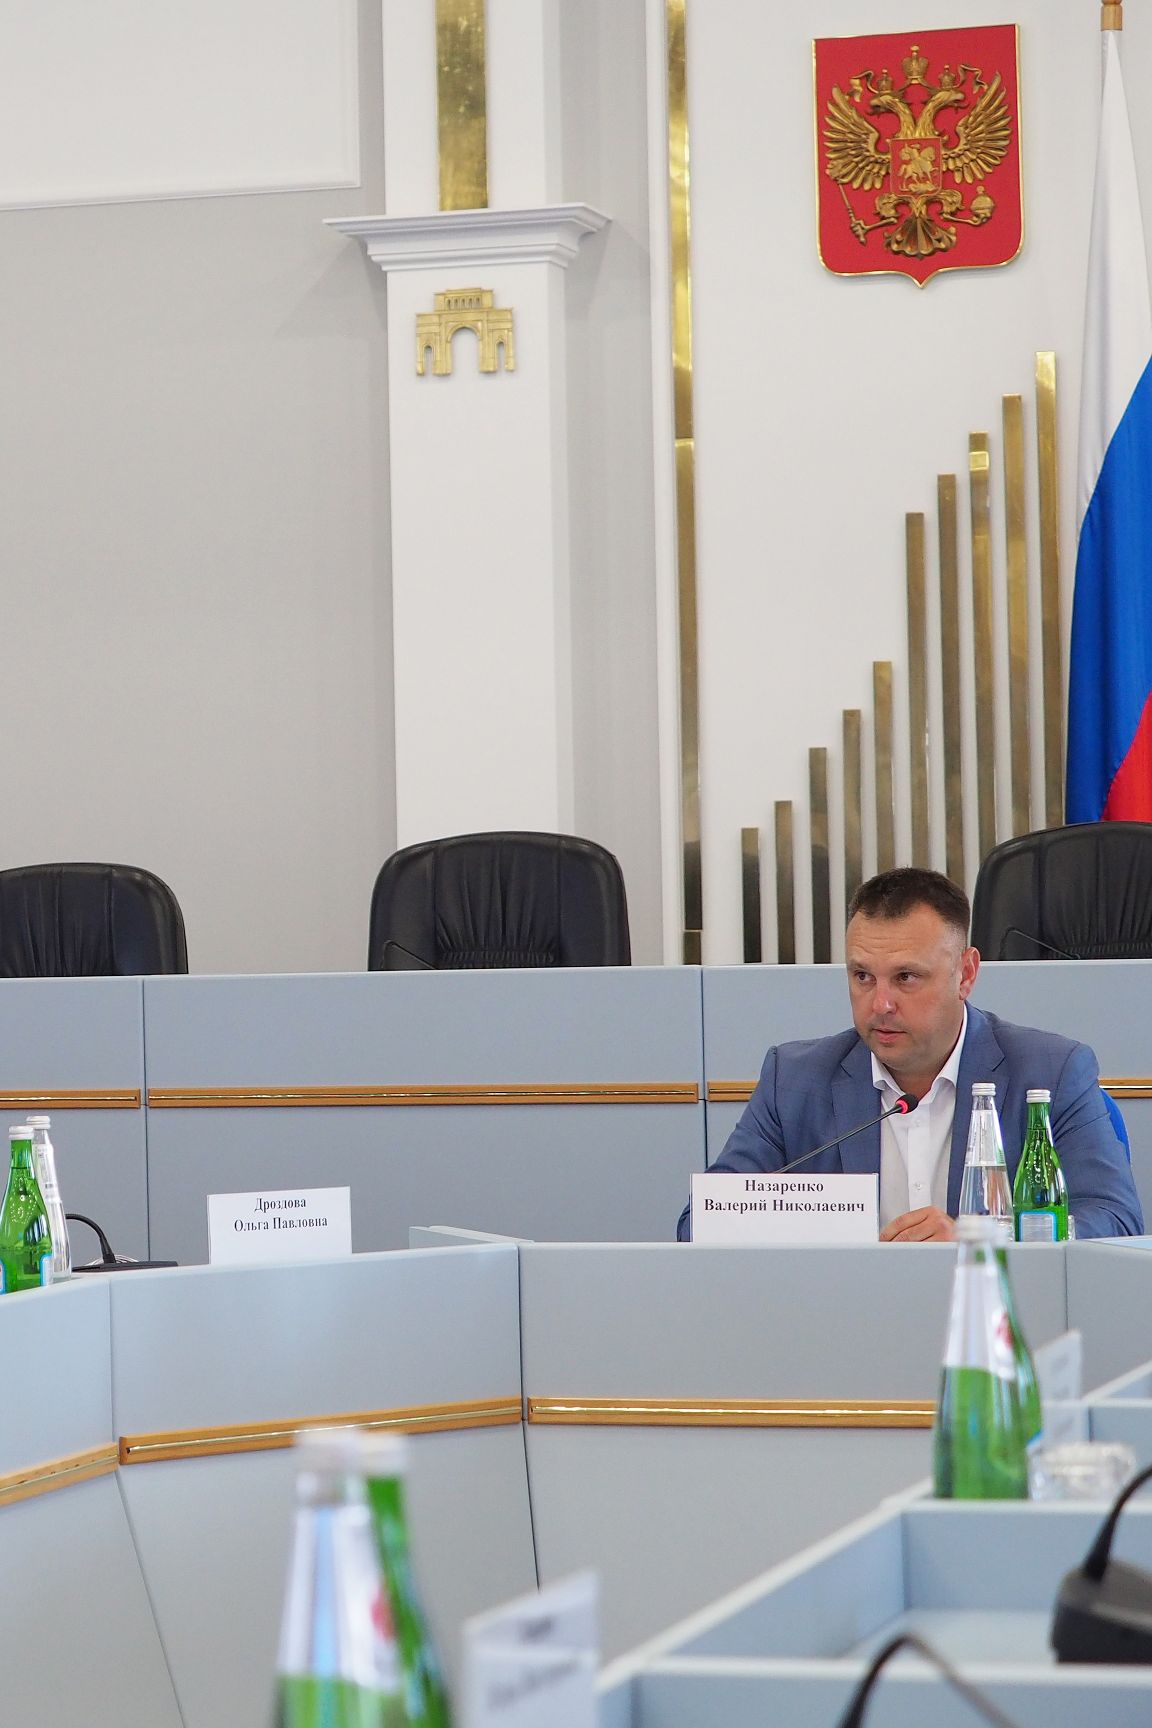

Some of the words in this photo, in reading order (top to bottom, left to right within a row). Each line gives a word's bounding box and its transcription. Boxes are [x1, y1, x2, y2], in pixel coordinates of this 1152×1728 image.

[745, 1179, 824, 1195] Назаренко
[254, 1198, 306, 1213] Дроздова
[704, 1198, 767, 1214] Валерий
[772, 1199, 865, 1212] Николаевич
[234, 1219, 269, 1232] Ольга
[273, 1217, 328, 1230] Павловна
